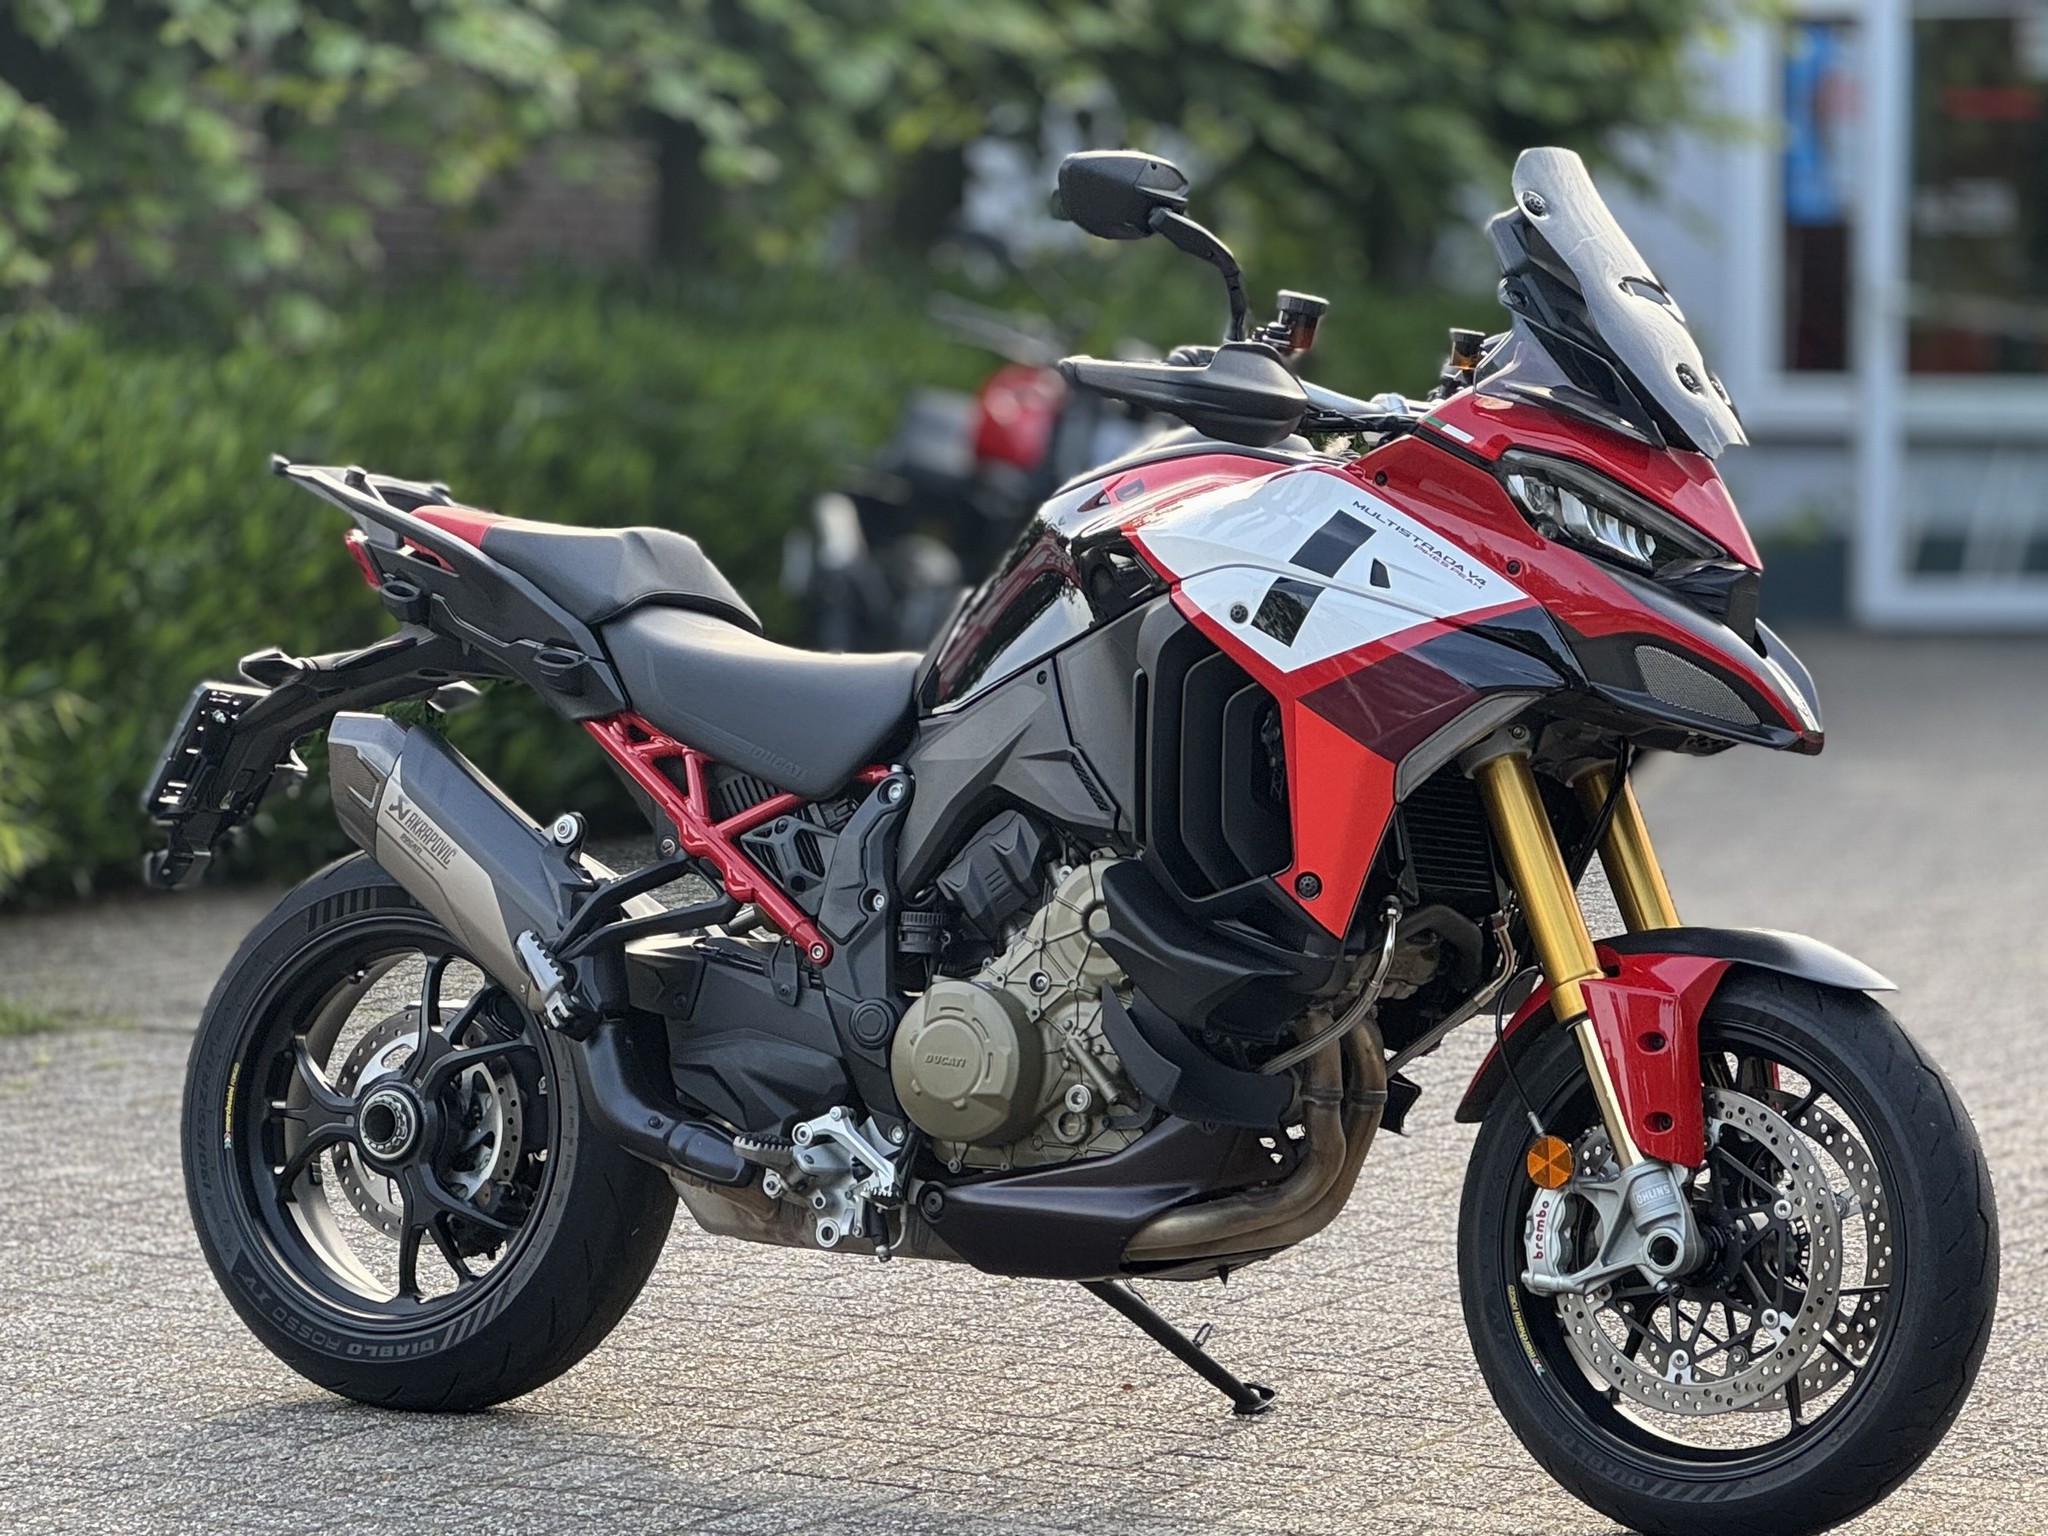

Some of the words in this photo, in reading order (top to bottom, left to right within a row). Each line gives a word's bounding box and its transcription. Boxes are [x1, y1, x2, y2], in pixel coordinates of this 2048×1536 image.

[1352, 500, 1464, 573] MULTISTRADA
[1468, 570, 1486, 585] V4
[924, 1054, 967, 1068] DUCATI
[1533, 1200, 1550, 1259] brembo
[272, 1307, 340, 1351] ROSSO
[347, 1338, 435, 1357] DIABLO
